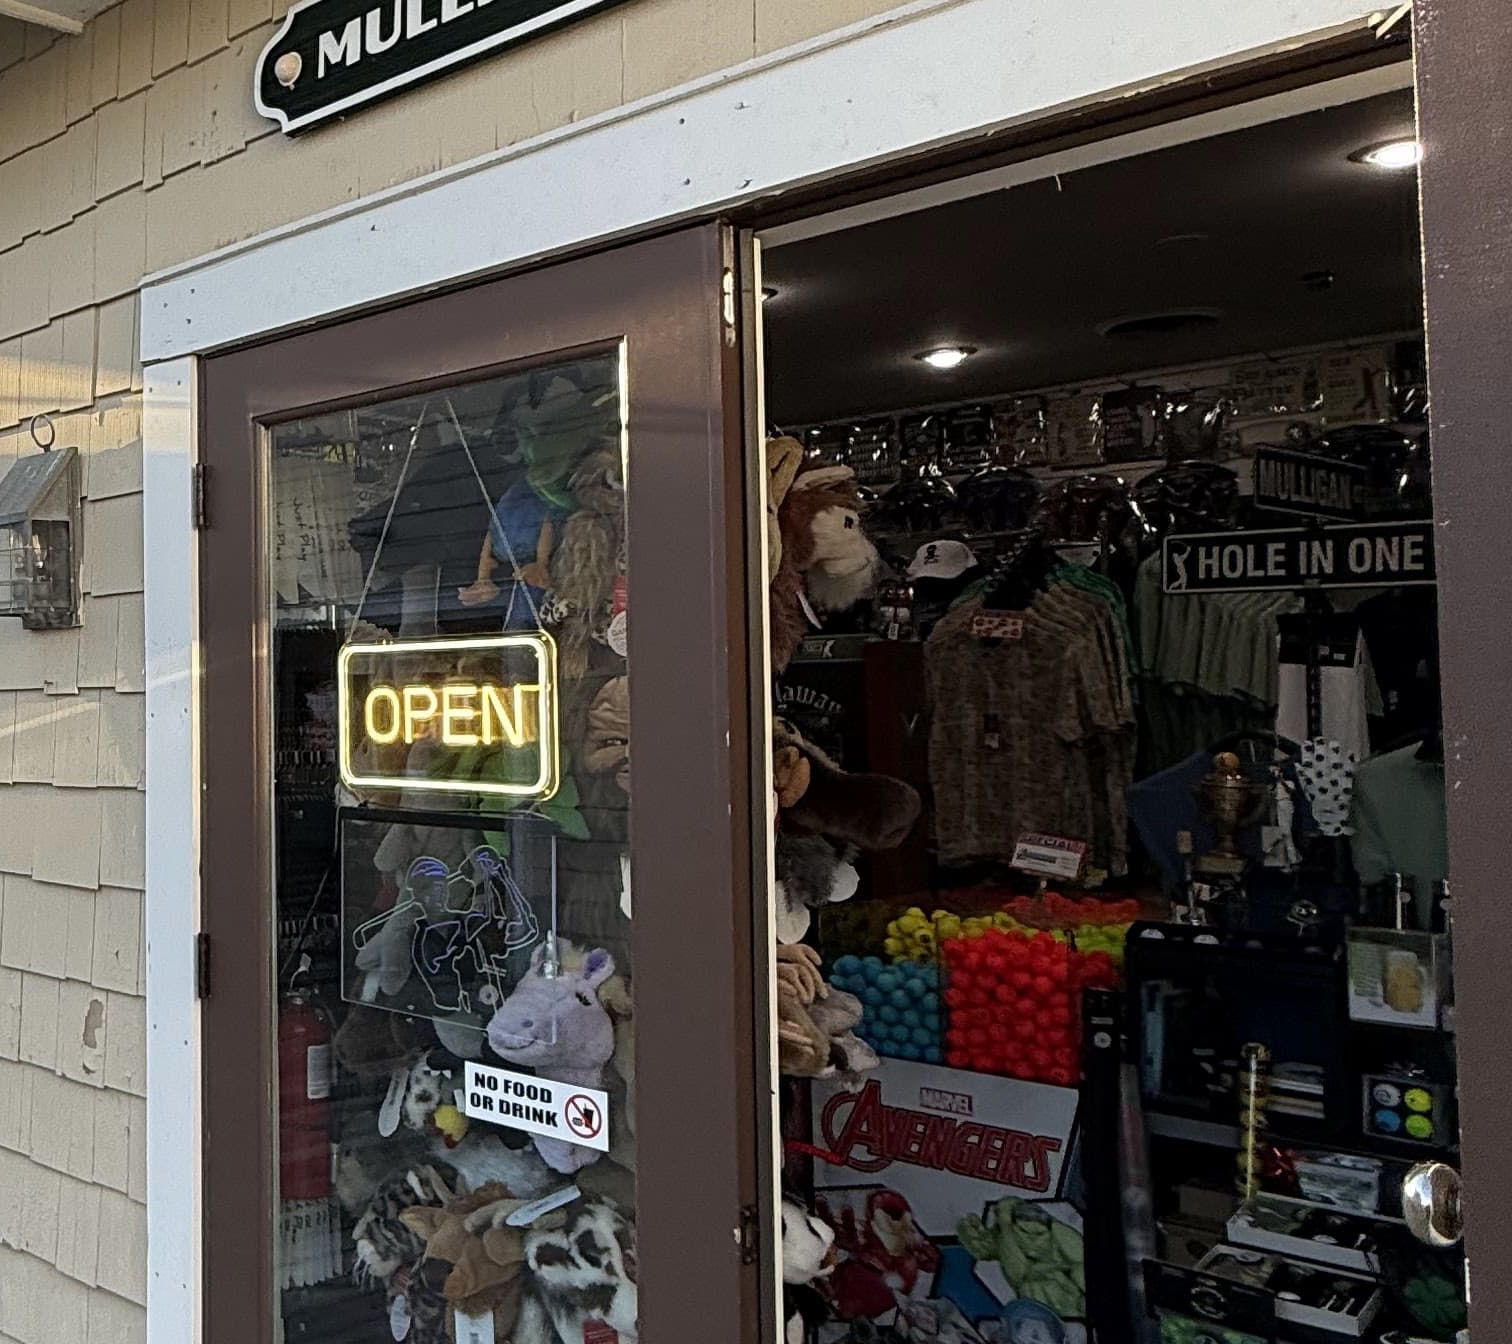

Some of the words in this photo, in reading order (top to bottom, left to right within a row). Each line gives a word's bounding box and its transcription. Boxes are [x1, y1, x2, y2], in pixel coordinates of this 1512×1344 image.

[1258, 457, 1352, 510] MULLIGAN
[1197, 541, 1288, 580] HOLE
[1298, 538, 1335, 576] IN
[1347, 534, 1426, 574] ONE
[364, 683, 527, 748] OPEN
[470, 1092, 494, 1112] OR
[499, 1098, 559, 1128] DRINK
[474, 1071, 498, 1091] NO
[503, 1078, 553, 1104] FOOD
